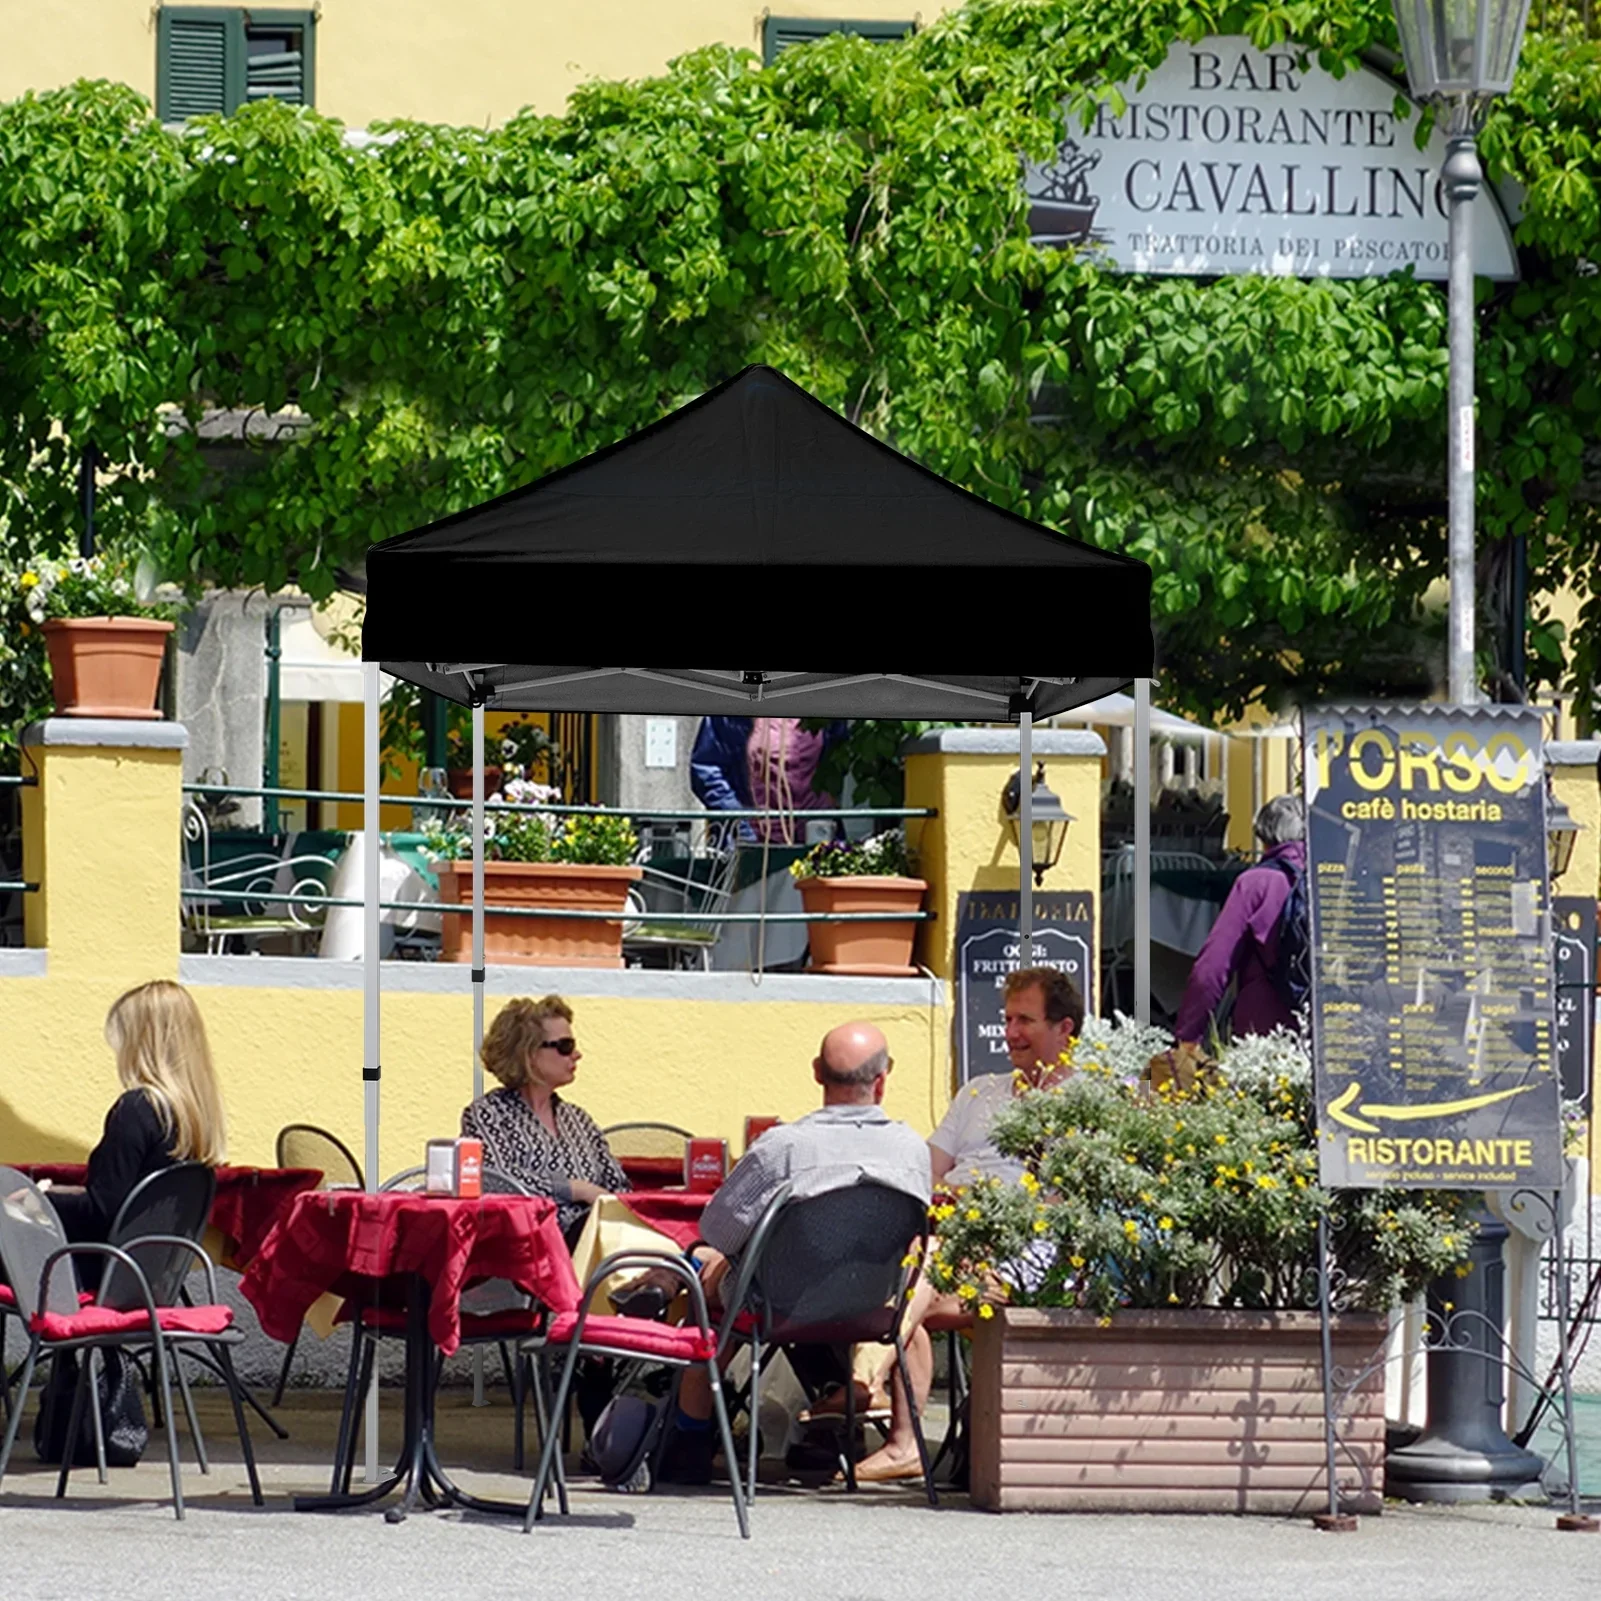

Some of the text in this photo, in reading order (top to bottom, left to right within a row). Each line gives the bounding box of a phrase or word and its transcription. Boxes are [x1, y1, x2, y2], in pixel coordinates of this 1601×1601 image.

[1189, 51, 1300, 93] BAR
[1093, 102, 1395, 148] RISTORANTE
[1128, 233, 1264, 256] TRATTORIA
[1279, 237, 1320, 258] DEI
[1401, 798, 1501, 821] hostaria
[969, 902, 1088, 921] TRATORIA
[1348, 1137, 1532, 1166] RISTORANTE
